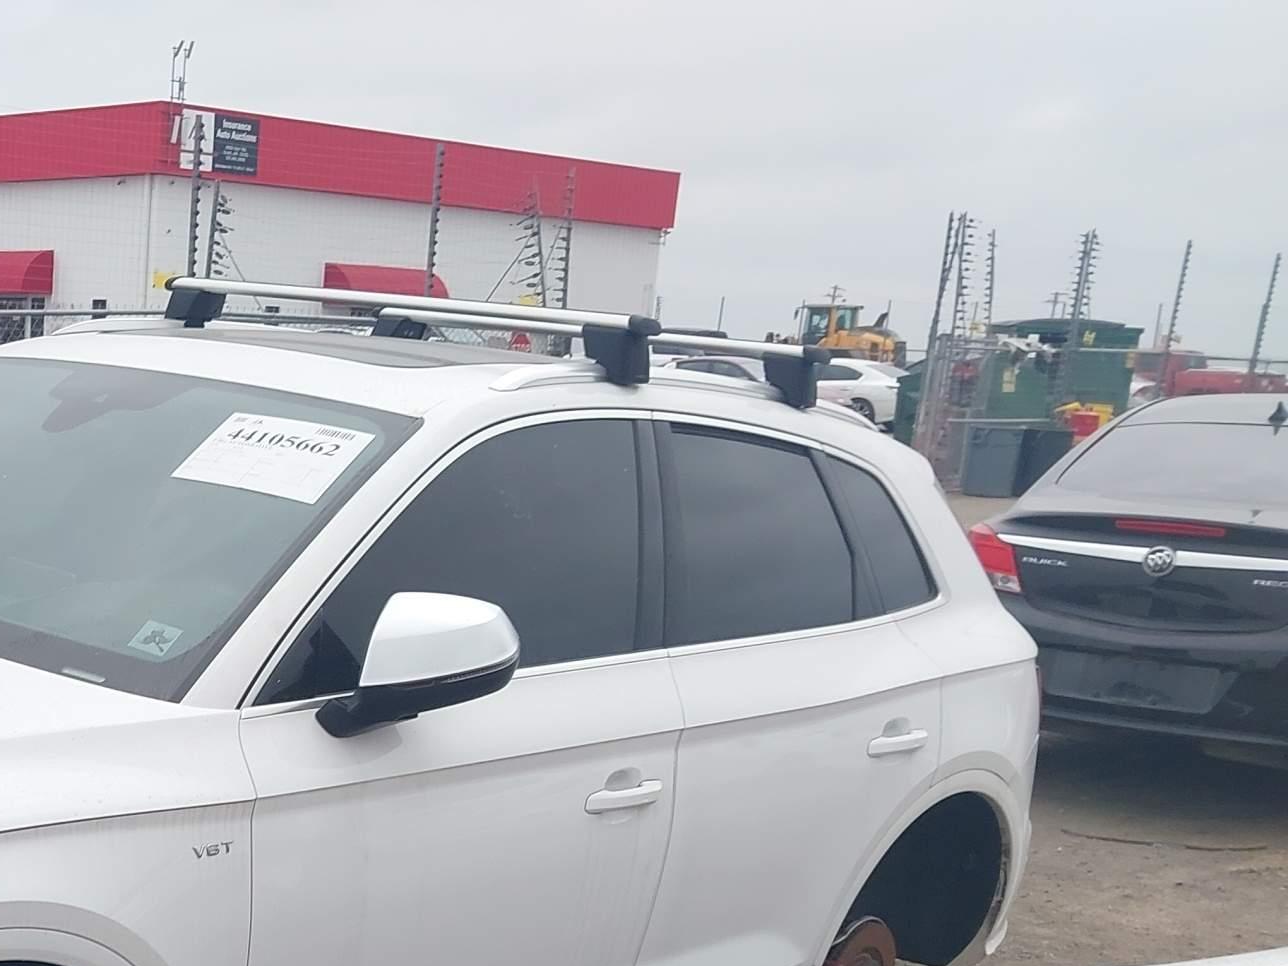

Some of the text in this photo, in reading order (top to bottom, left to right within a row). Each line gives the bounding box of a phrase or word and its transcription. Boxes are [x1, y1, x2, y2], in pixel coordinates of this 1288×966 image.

[226, 427, 341, 457] 44105662
[1022, 556, 1070, 567] BUICK
[192, 841, 233, 859] V6T
